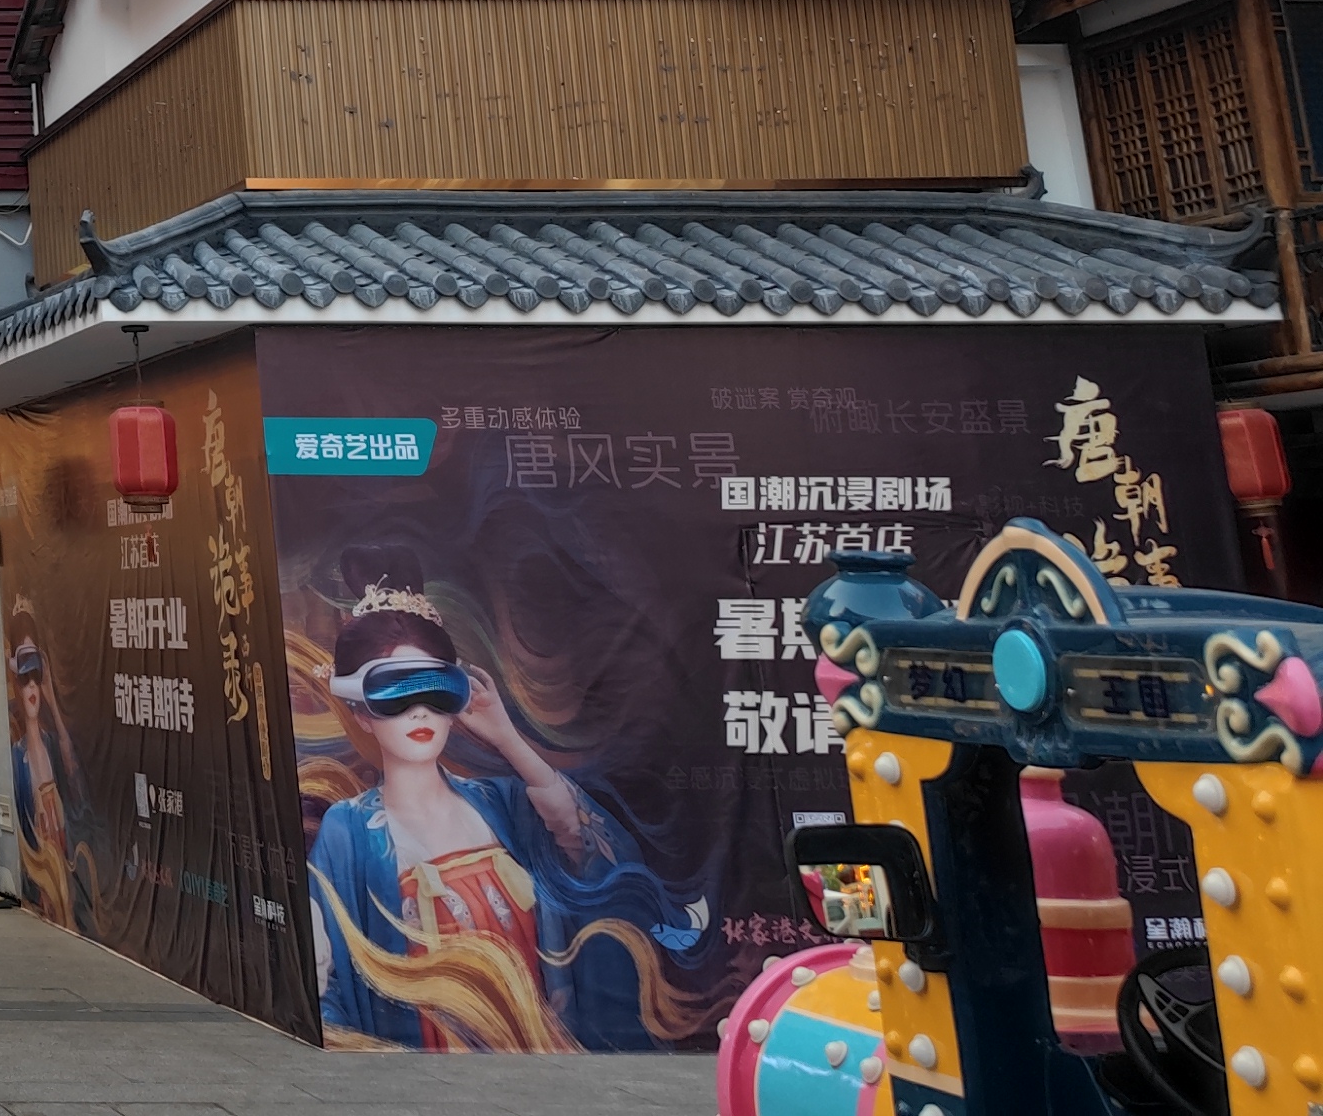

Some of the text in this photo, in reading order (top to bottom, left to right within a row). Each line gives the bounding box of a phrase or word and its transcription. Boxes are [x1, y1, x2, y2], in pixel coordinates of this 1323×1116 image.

[710, 386, 857, 411] 破谜案 赏奇观
[809, 399, 1031, 434] 俯瞰长安盛景
[440, 405, 583, 431] 多重动感体验
[294, 433, 420, 461] 爱奇艺出品
[504, 430, 741, 491] 唐风实景
[720, 476, 952, 513] 国潮沉浸剧场
[108, 596, 189, 651] 暑期开业
[113, 672, 195, 734] 敬请期待
